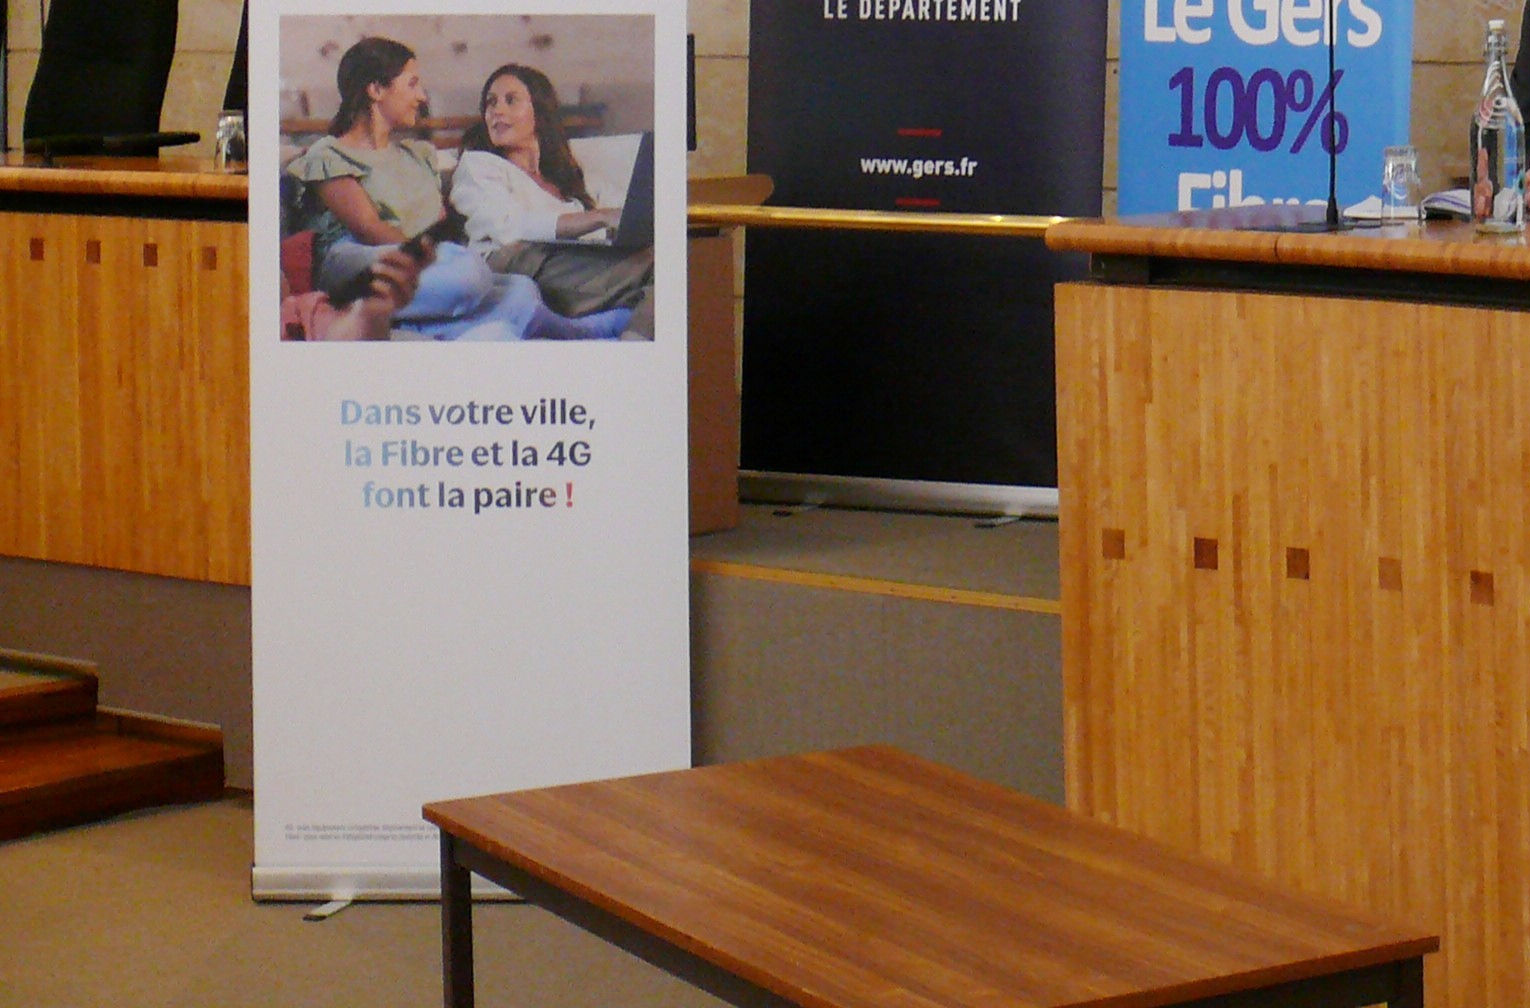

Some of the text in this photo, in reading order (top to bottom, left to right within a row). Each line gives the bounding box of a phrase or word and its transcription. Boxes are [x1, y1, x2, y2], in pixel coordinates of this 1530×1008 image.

[1168, 66, 1350, 155] 100%
[860, 157, 978, 180] www.gers.fr
[340, 398, 596, 430] Dans votre ville,
[344, 440, 592, 467] la Fibre et la 4G
[362, 480, 574, 514] font la paire !
